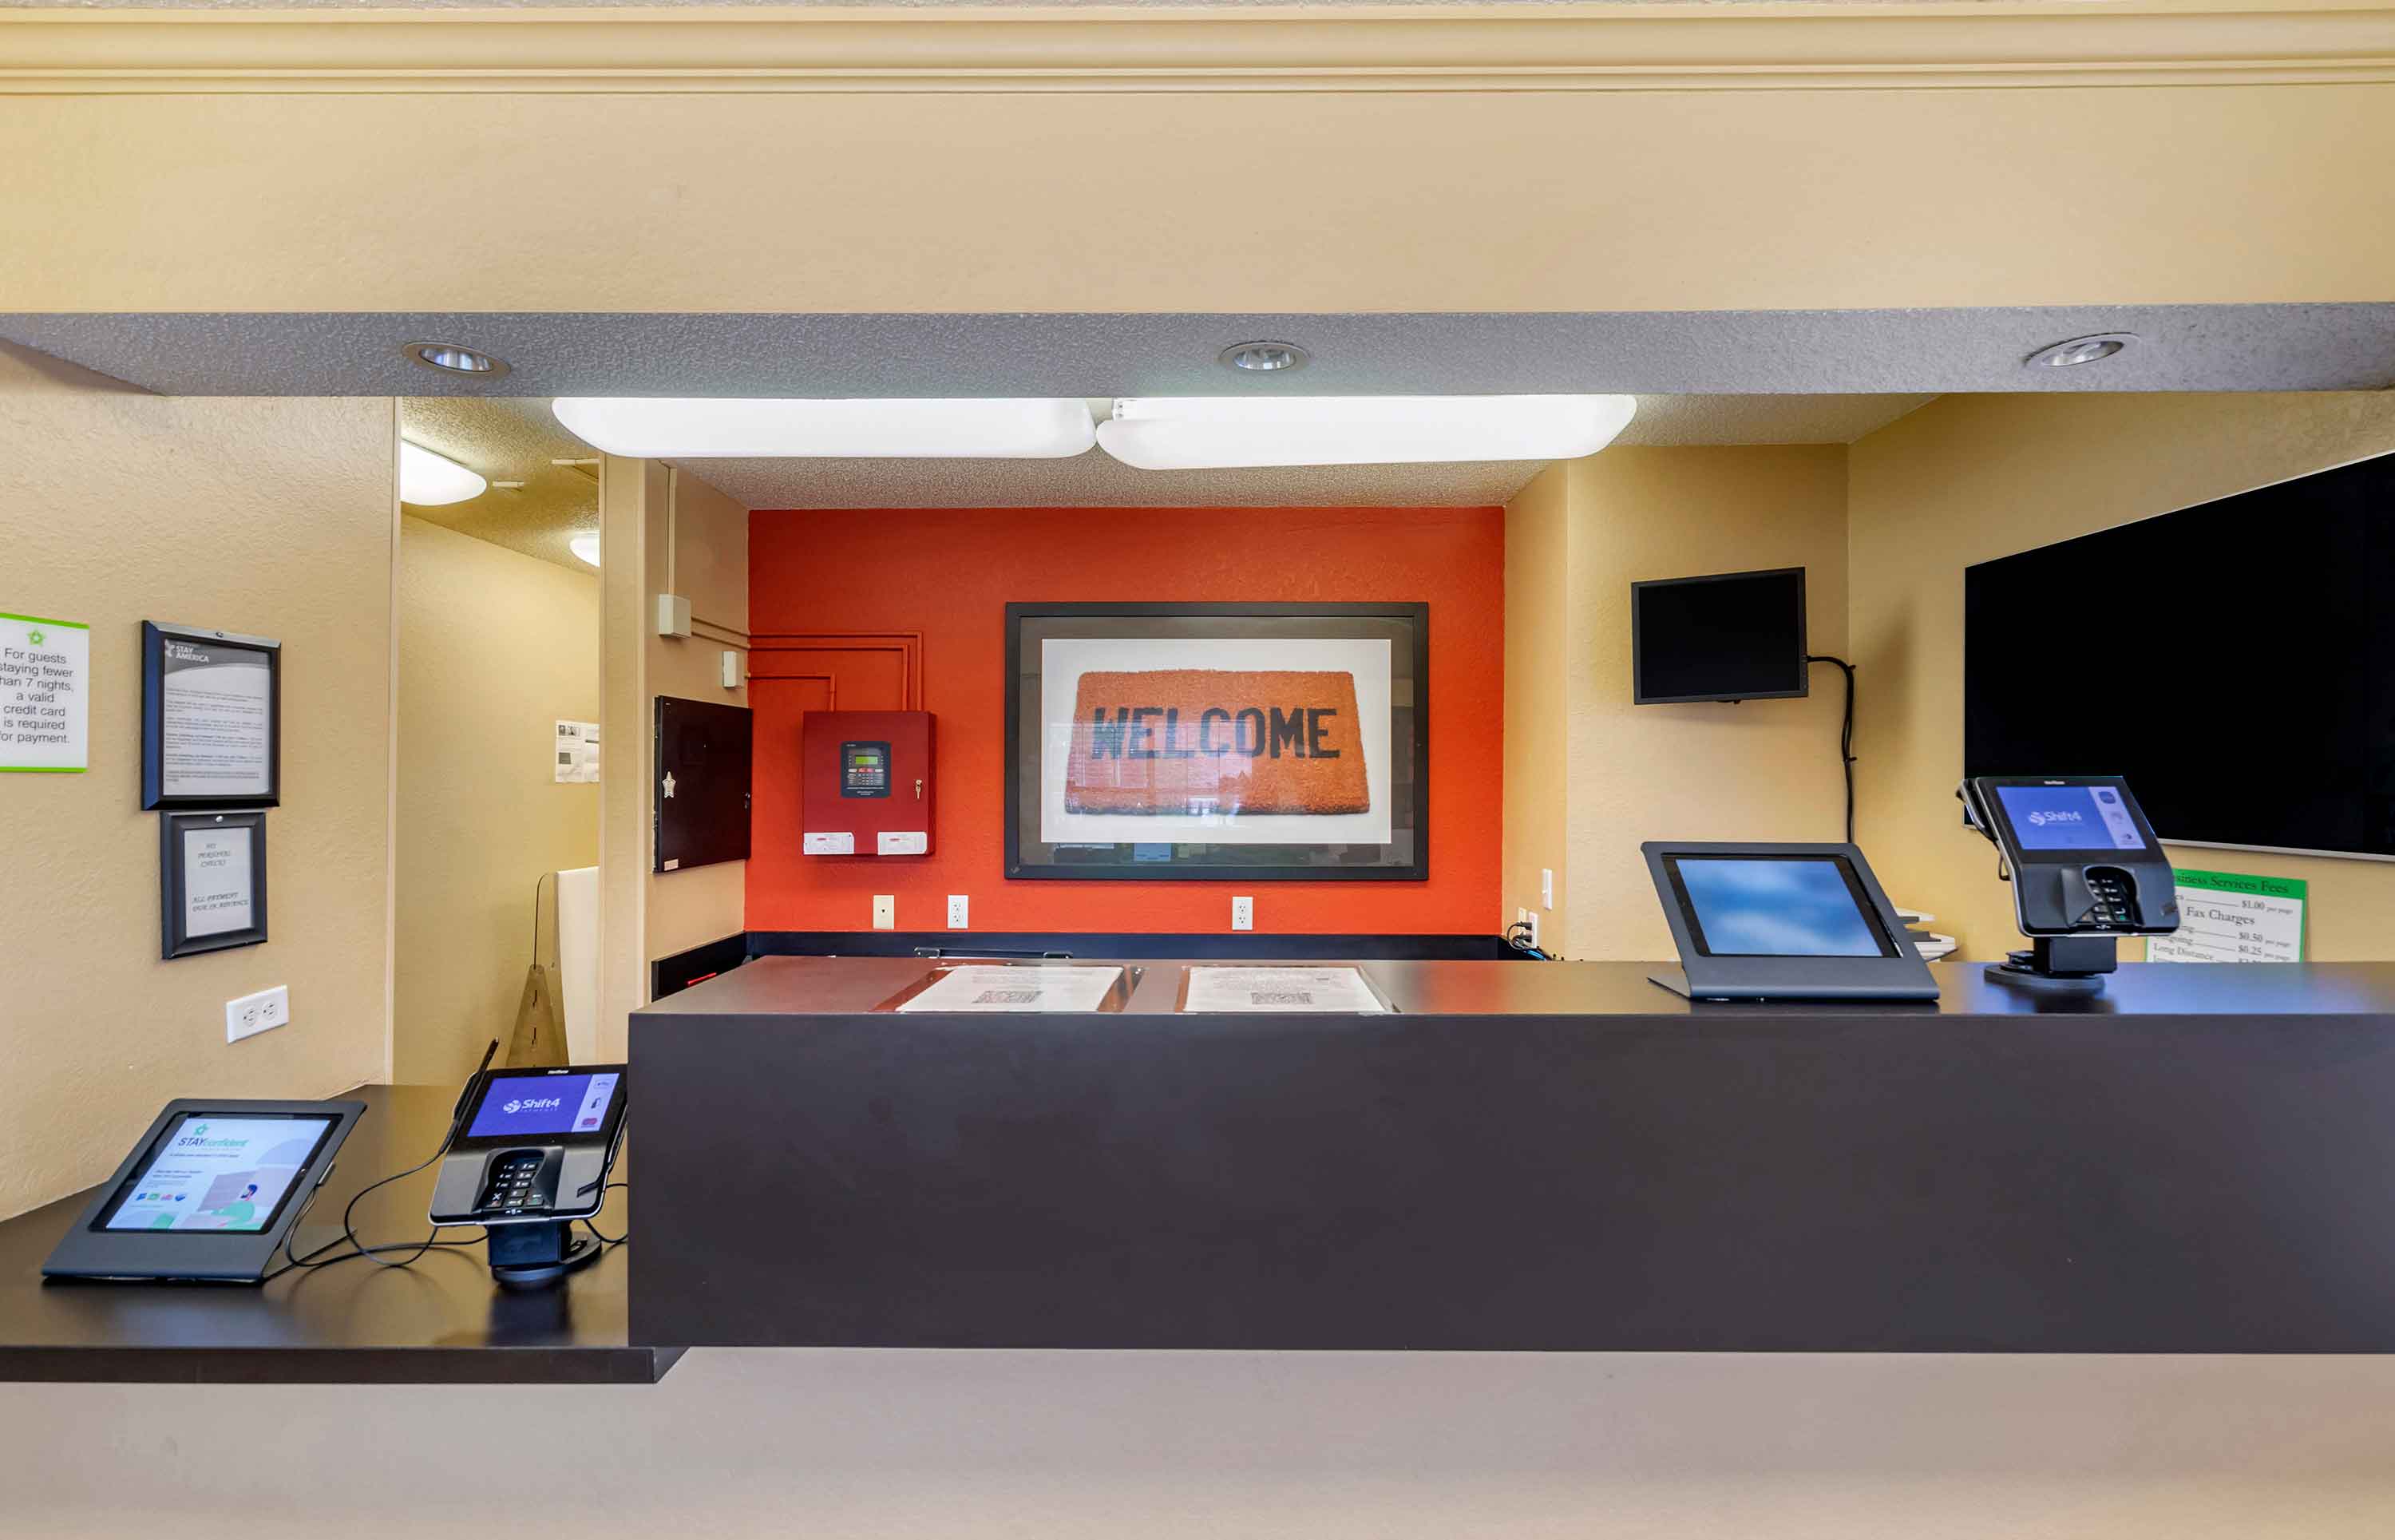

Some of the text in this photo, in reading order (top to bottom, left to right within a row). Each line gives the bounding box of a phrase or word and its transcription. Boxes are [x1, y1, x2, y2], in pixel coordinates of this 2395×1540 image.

[5, 647, 67, 664] For guests
[176, 652, 209, 663] AMERICA
[43, 665, 73, 678] fewer
[0, 676, 74, 692] han 7 nights,
[16, 691, 54, 703] a valid
[3, 704, 65, 717] credit card
[4, 719, 65, 731] is required
[0, 731, 70, 745] or payment.
[1091, 707, 1341, 760] WELCOME
[2177, 873, 2289, 893] siness Services Fees
[2242, 900, 2266, 910] $1.00
[2187, 906, 2255, 927] Fax Charges
[2239, 932, 2263, 943] $0.50
[2153, 943, 2175, 956] Long
[2238, 944, 2262, 955] $0.25
[522, 1098, 561, 1108] Shift4
